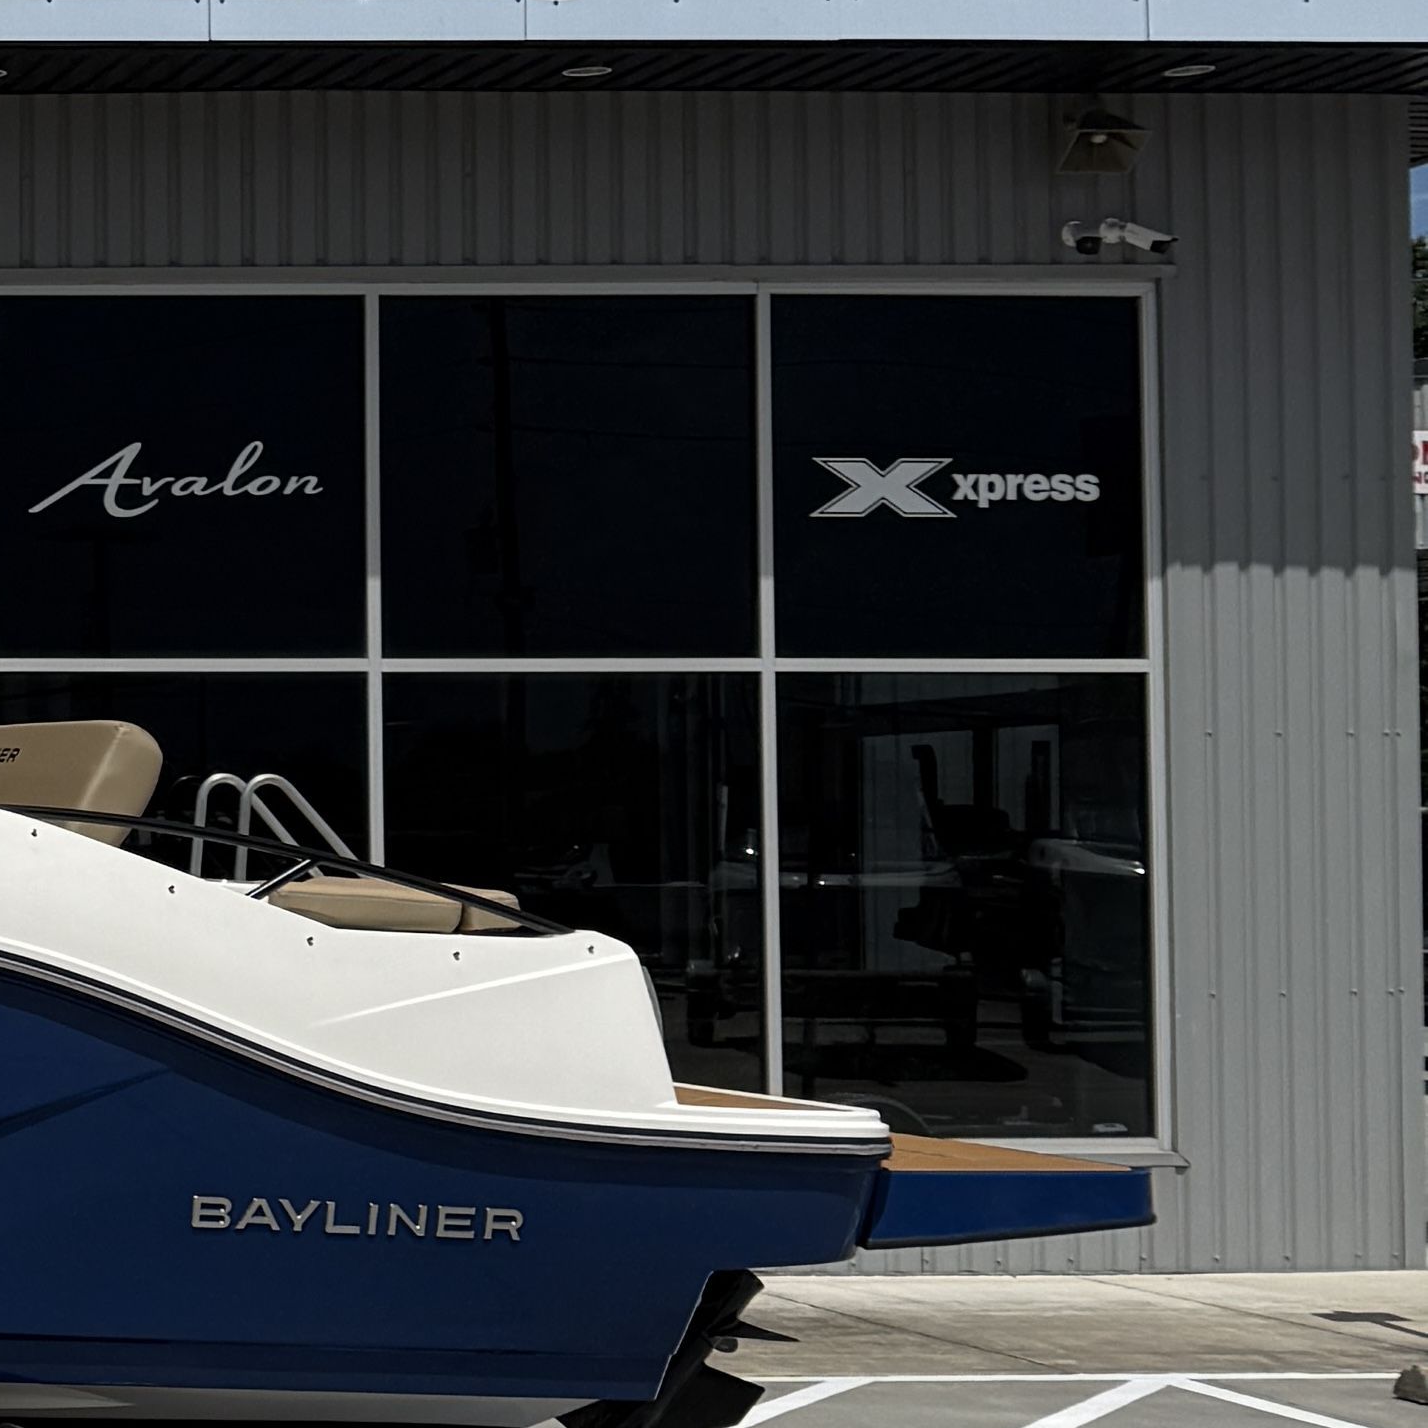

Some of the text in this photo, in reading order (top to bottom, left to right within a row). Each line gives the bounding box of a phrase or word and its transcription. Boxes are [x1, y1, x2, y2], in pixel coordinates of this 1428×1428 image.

[27, 440, 325, 518] Avalon
[951, 471, 1101, 509] xpress
[189, 1193, 526, 1242] BAYLINER
